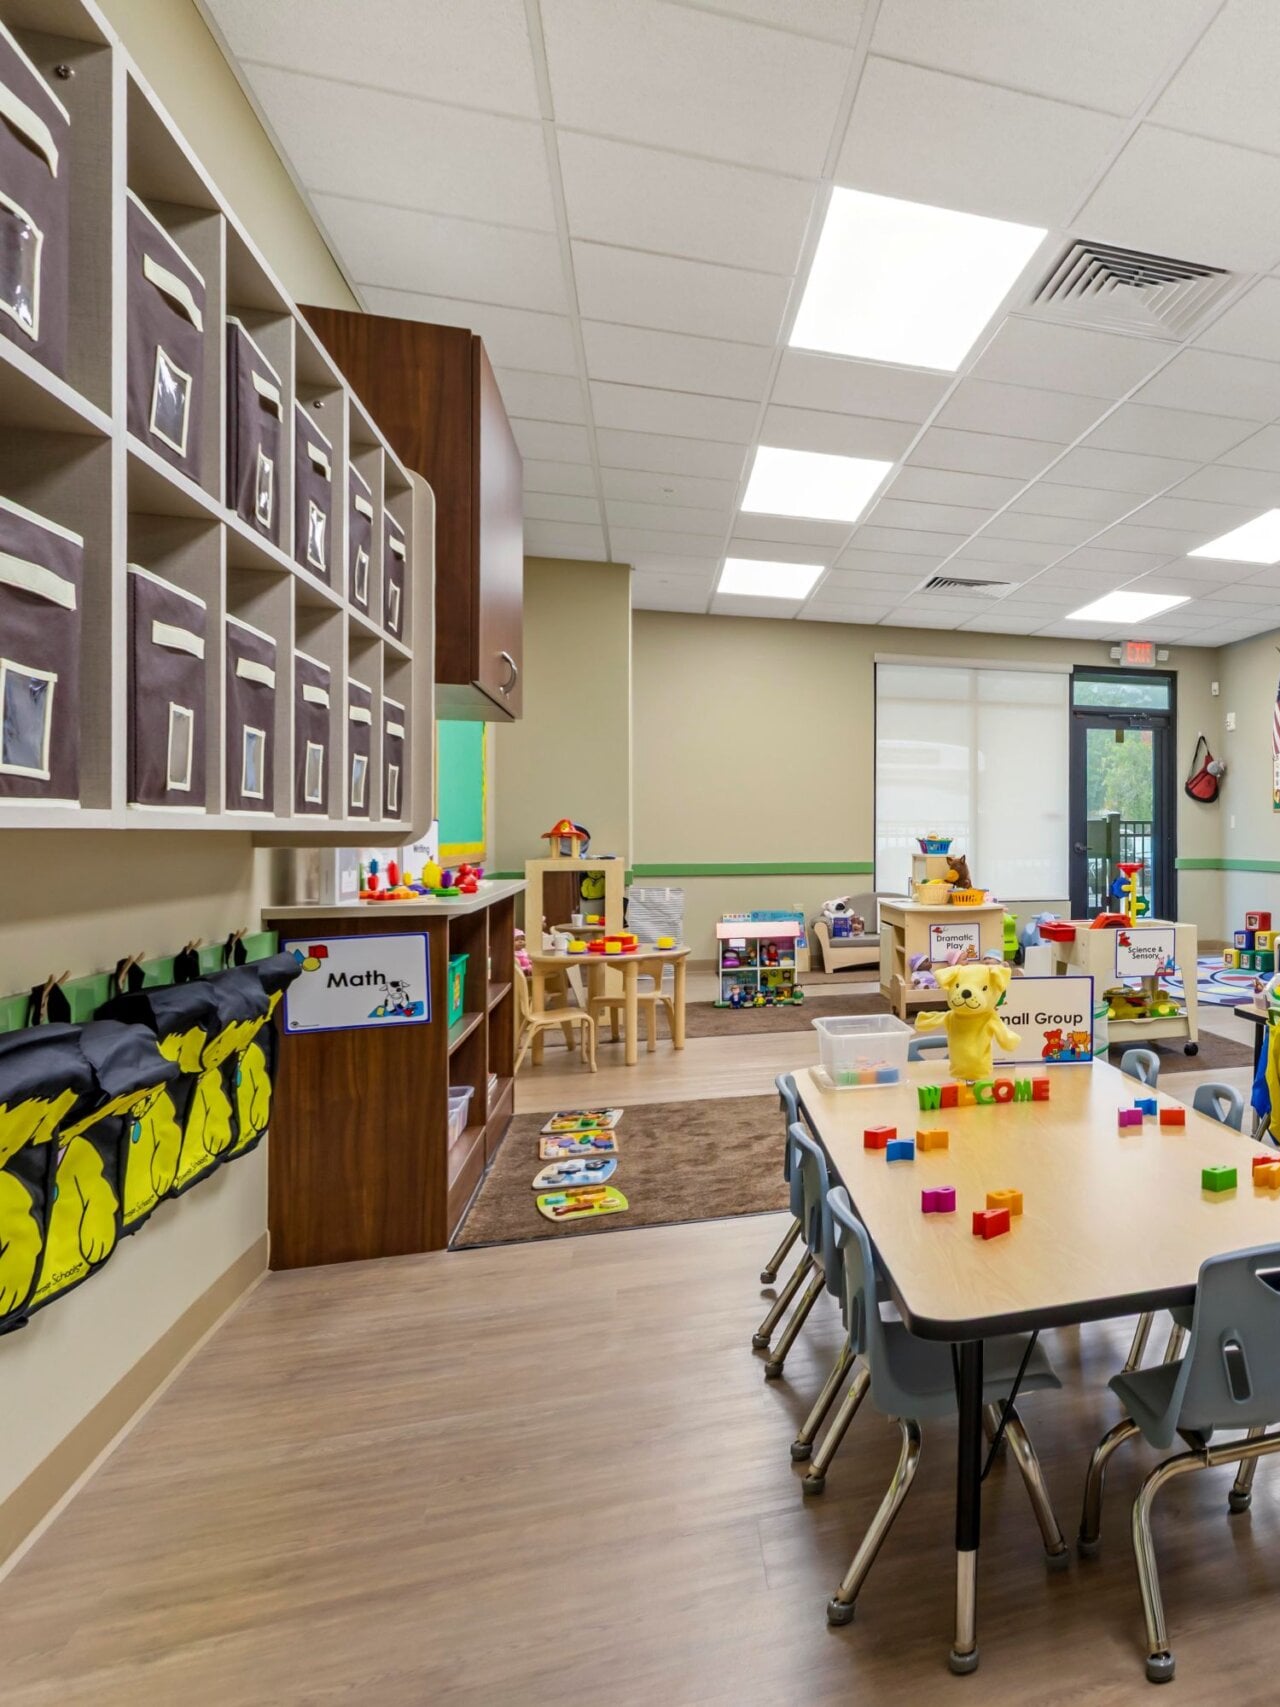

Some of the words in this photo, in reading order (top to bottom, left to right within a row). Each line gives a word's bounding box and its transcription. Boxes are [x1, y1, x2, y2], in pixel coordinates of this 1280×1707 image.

[936, 934, 974, 942] Dramatic
[946, 942, 964, 951] Play
[1128, 946, 1157, 954] Science
[1132, 952, 1159, 960] Sensory
[327, 969, 387, 988] Math
[1000, 1012, 1030, 1025] mall
[1034, 1012, 1083, 1026] Group
[917, 1076, 1051, 1111] WELCOME
